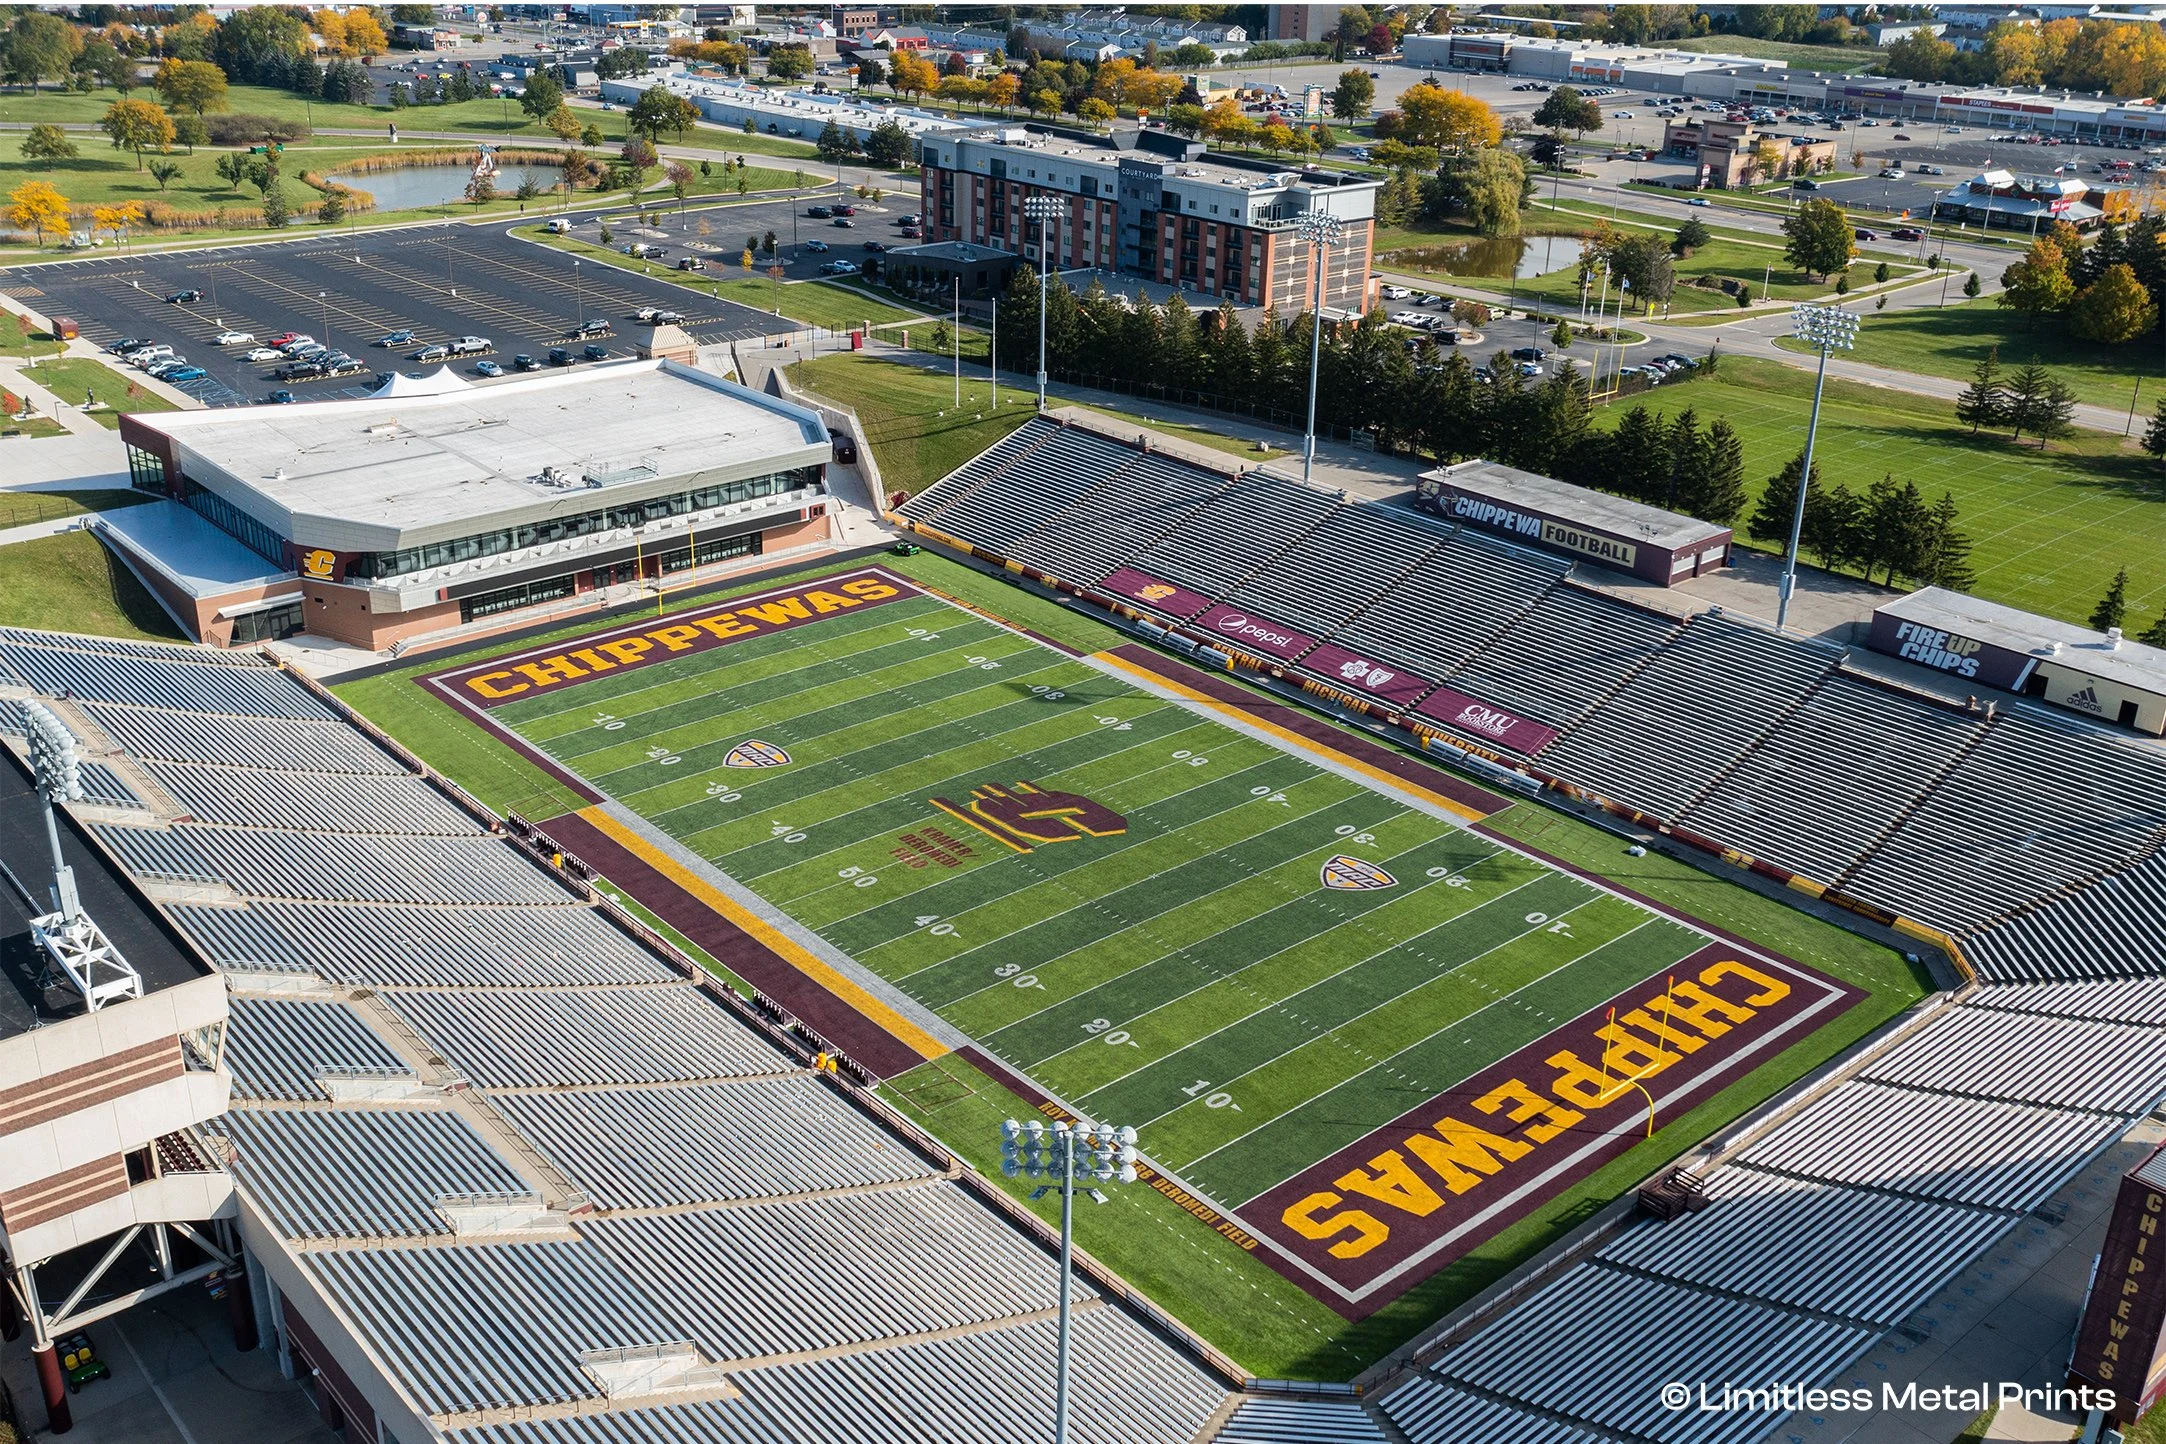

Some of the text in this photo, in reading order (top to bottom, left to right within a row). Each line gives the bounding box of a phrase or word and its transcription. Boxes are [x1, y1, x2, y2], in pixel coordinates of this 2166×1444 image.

[1121, 167, 1158, 180] COURTYARD
[1455, 496, 1630, 563] CHIPPEWA FOOTBALL
[465, 579, 899, 698] CHIPPEWAS
[1239, 622, 1293, 648] pepsi
[1896, 621, 1982, 656] FIRE UP
[1213, 643, 1263, 673] CENTRAL
[1900, 642, 1981, 678] CHIPS
[1302, 679, 1370, 714] MICHIGAN
[2067, 694, 2103, 713] adidas
[592, 714, 626, 731] 10
[1456, 712, 1507, 736] BOOKSTORE
[1464, 704, 1519, 730] CMU
[1411, 723, 1500, 762] UNIVERSITY
[645, 748, 682, 766] 20
[706, 784, 743, 803] 30
[771, 826, 807, 844] 40
[889, 848, 928, 868] FIELD
[898, 833, 963, 868] DEROMEDI
[838, 866, 878, 888] 50
[914, 915, 954, 936] 40
[994, 963, 1039, 988] 30
[1080, 1018, 1131, 1046] 20
[1181, 1079, 1233, 1108] 10
[1281, 960, 1791, 1260] CHIPPEWAS
[1038, 1101, 1067, 1121] ROY
[1151, 1176, 1219, 1227] DEROMEDI
[1216, 1221, 1259, 1250] FIELD
[2098, 1193, 2163, 1380] CHIPPEWAS
